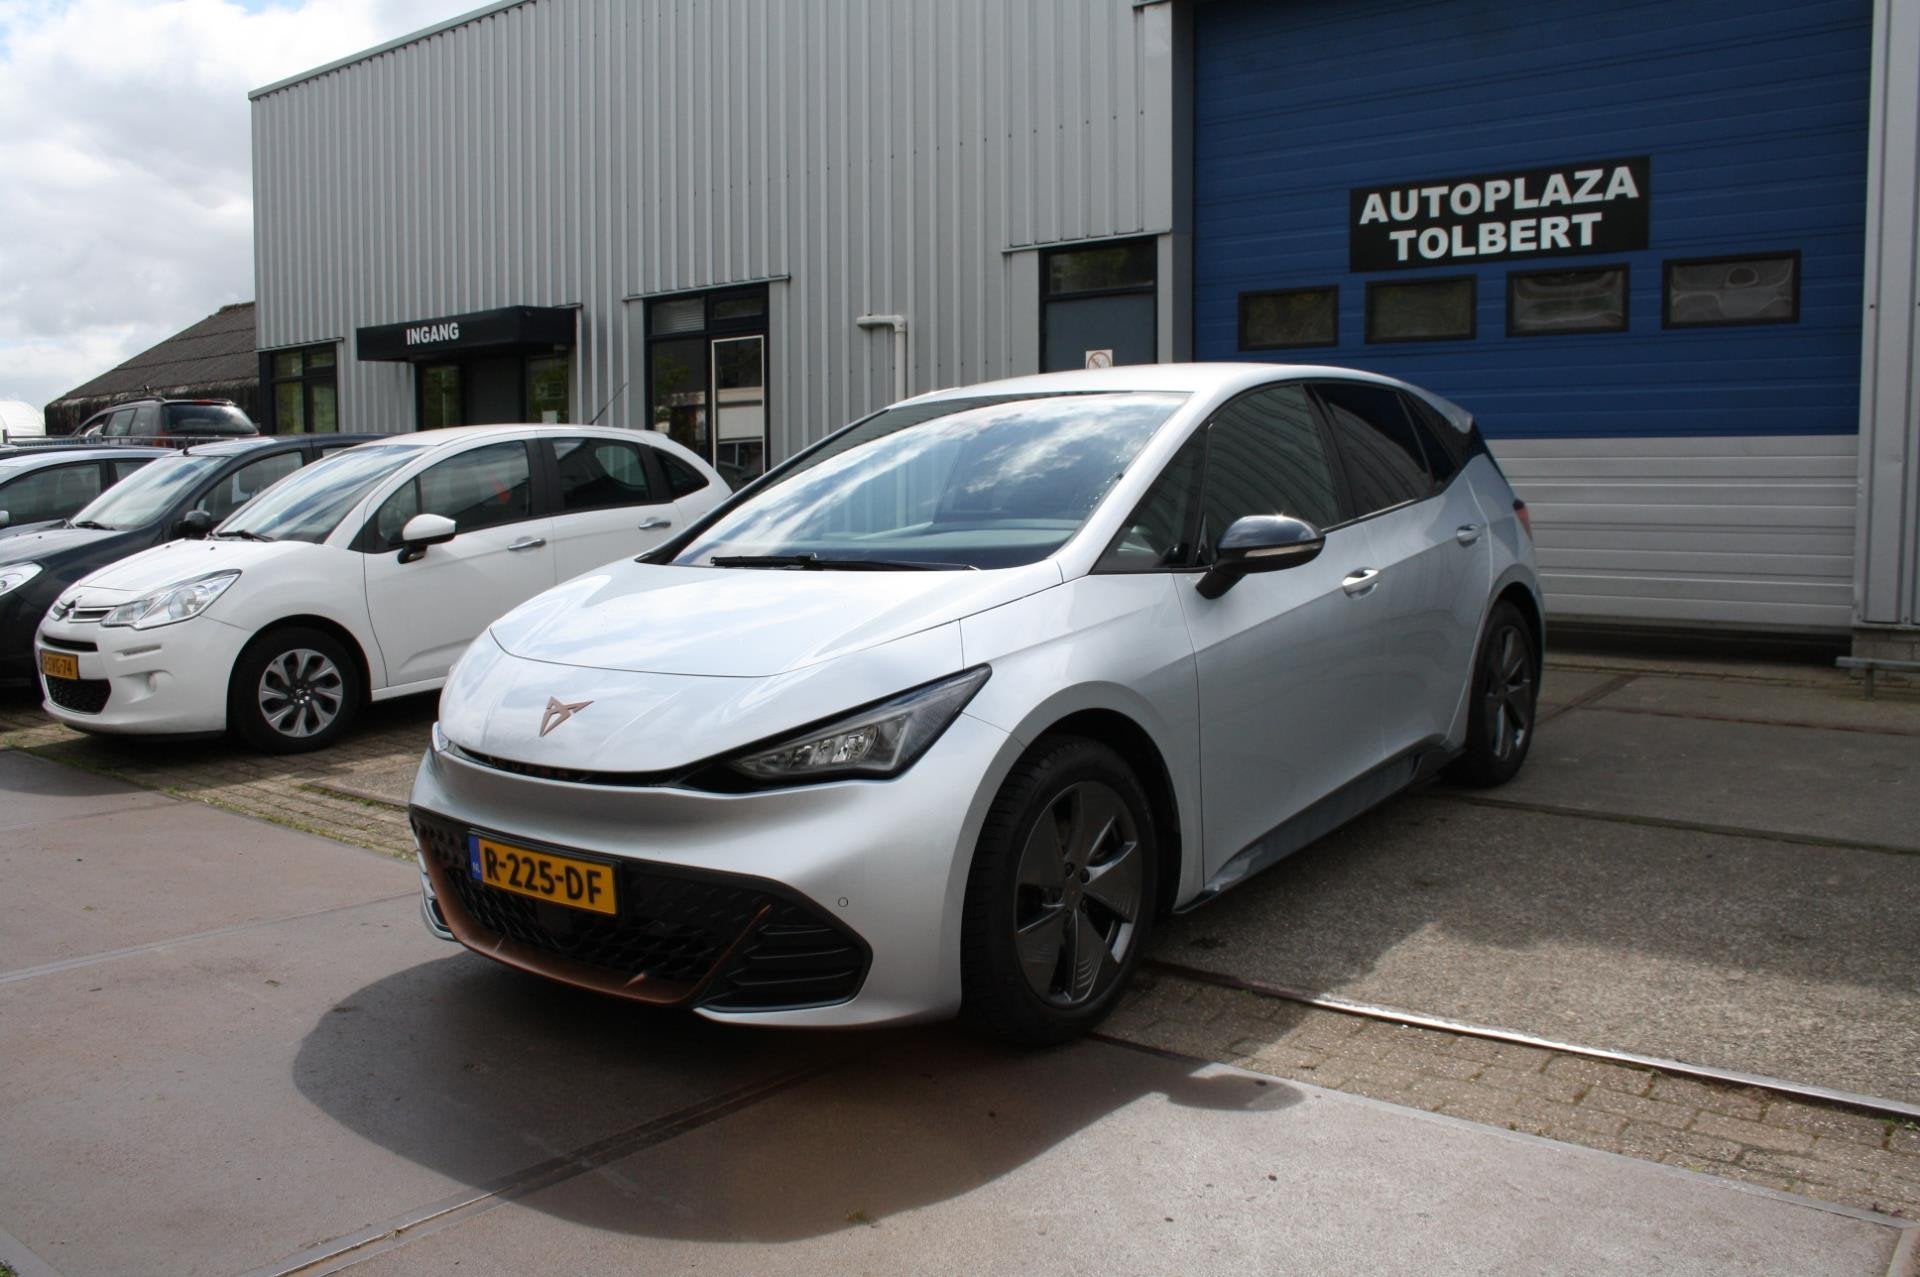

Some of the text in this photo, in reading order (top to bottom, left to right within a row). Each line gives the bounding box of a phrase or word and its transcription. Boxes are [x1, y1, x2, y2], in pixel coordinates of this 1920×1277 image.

[1359, 166, 1640, 225] AUTOPLAZA
[1389, 212, 1603, 261] TOLBERT
[406, 322, 460, 345] INGANG
[472, 862, 481, 873] NL
[484, 847, 602, 904] R-225-DF
